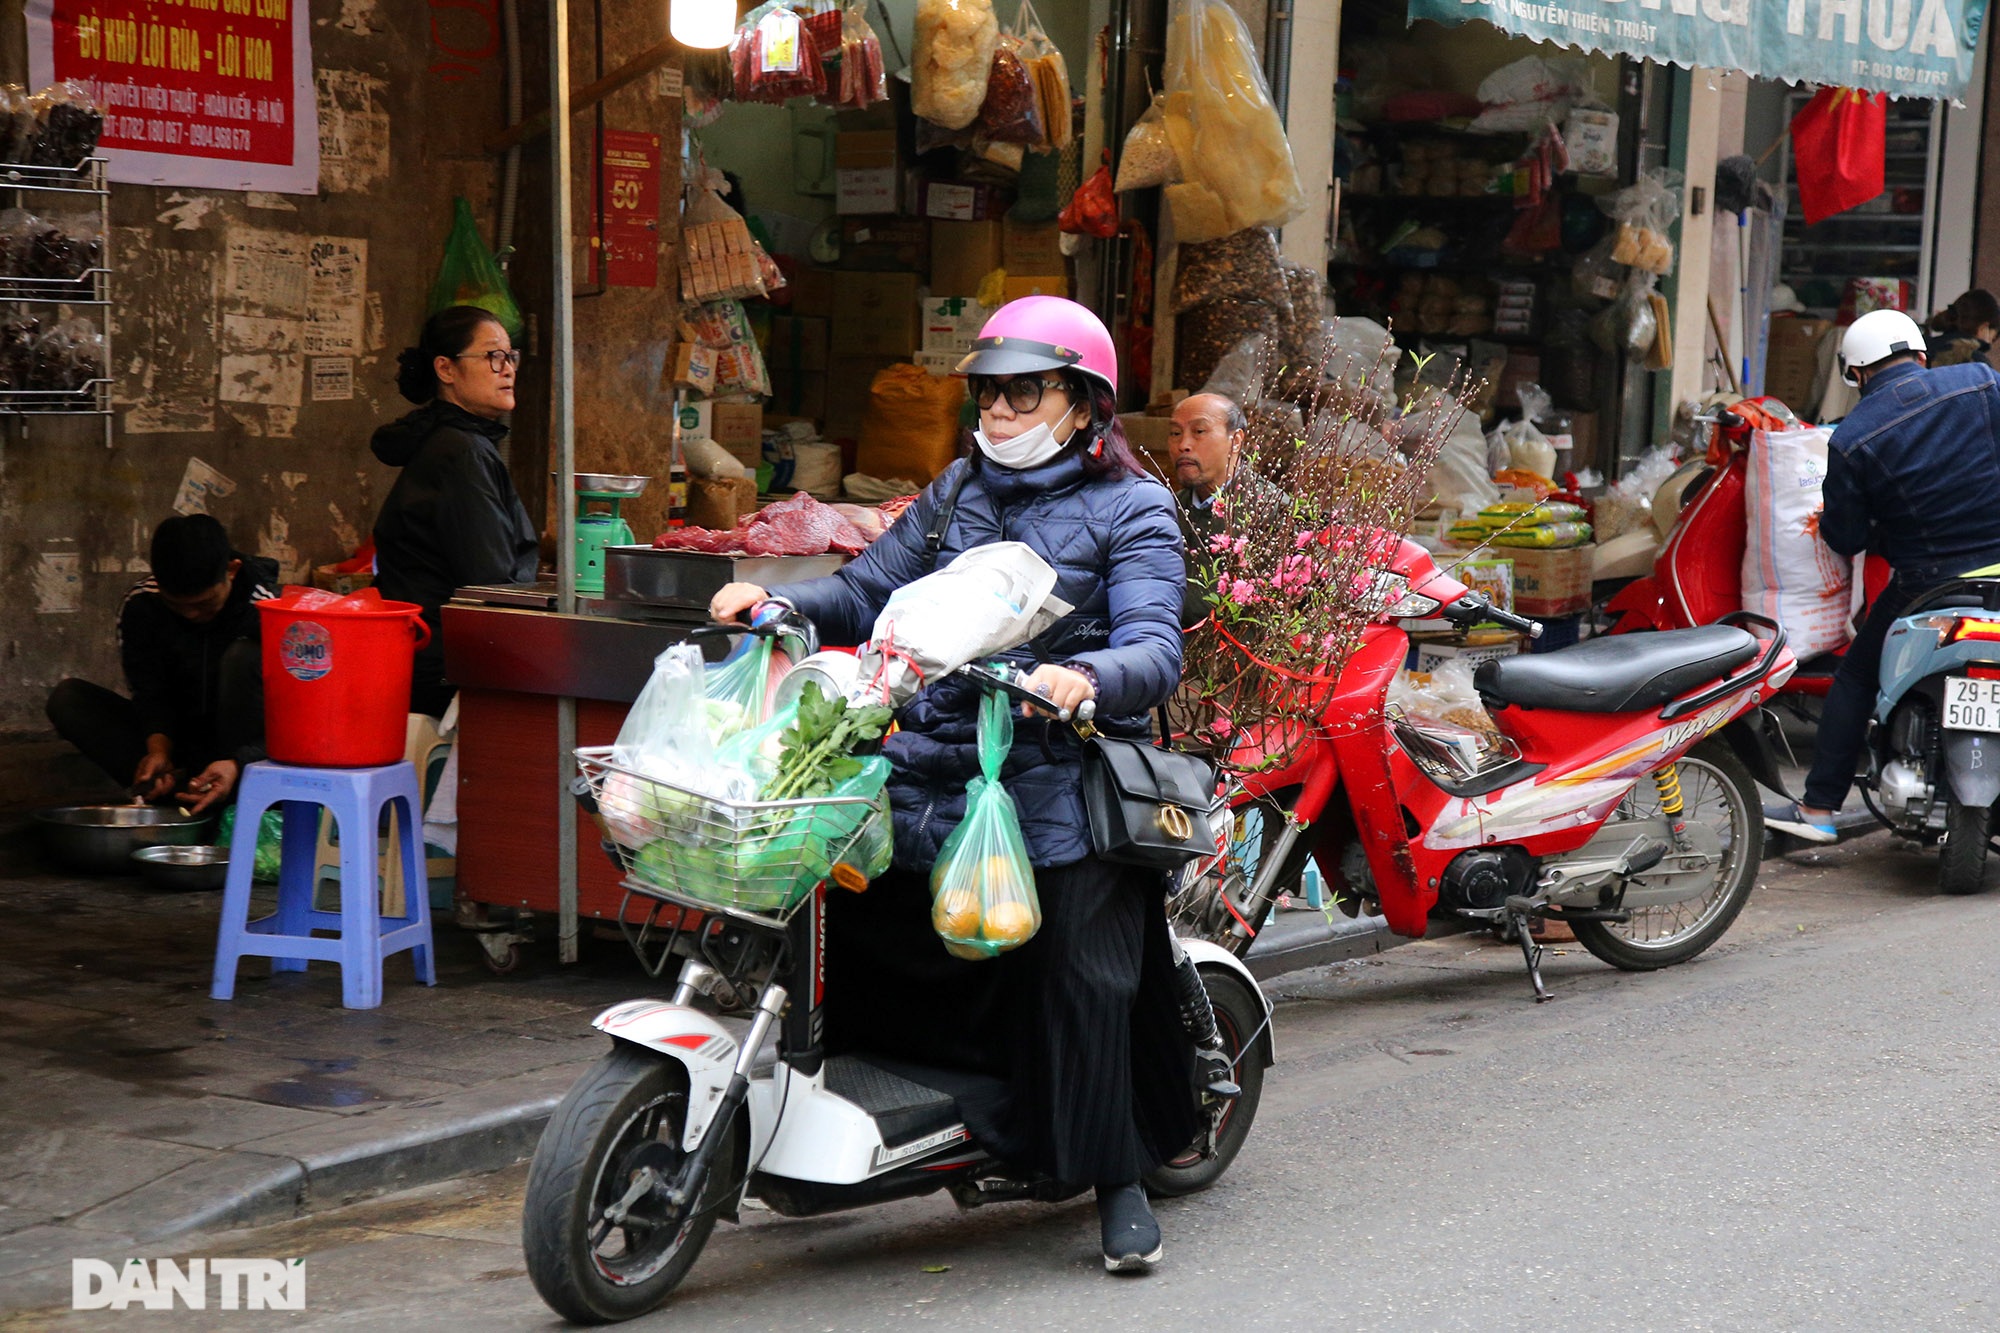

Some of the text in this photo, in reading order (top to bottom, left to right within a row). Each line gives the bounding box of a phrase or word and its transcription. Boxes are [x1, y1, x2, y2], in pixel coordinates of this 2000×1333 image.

[1571, 11, 1610, 36] THIỆN
[1614, 19, 1657, 45] THUẬT
[245, 36, 273, 81] HOA
[1661, 705, 1731, 754] Wave
